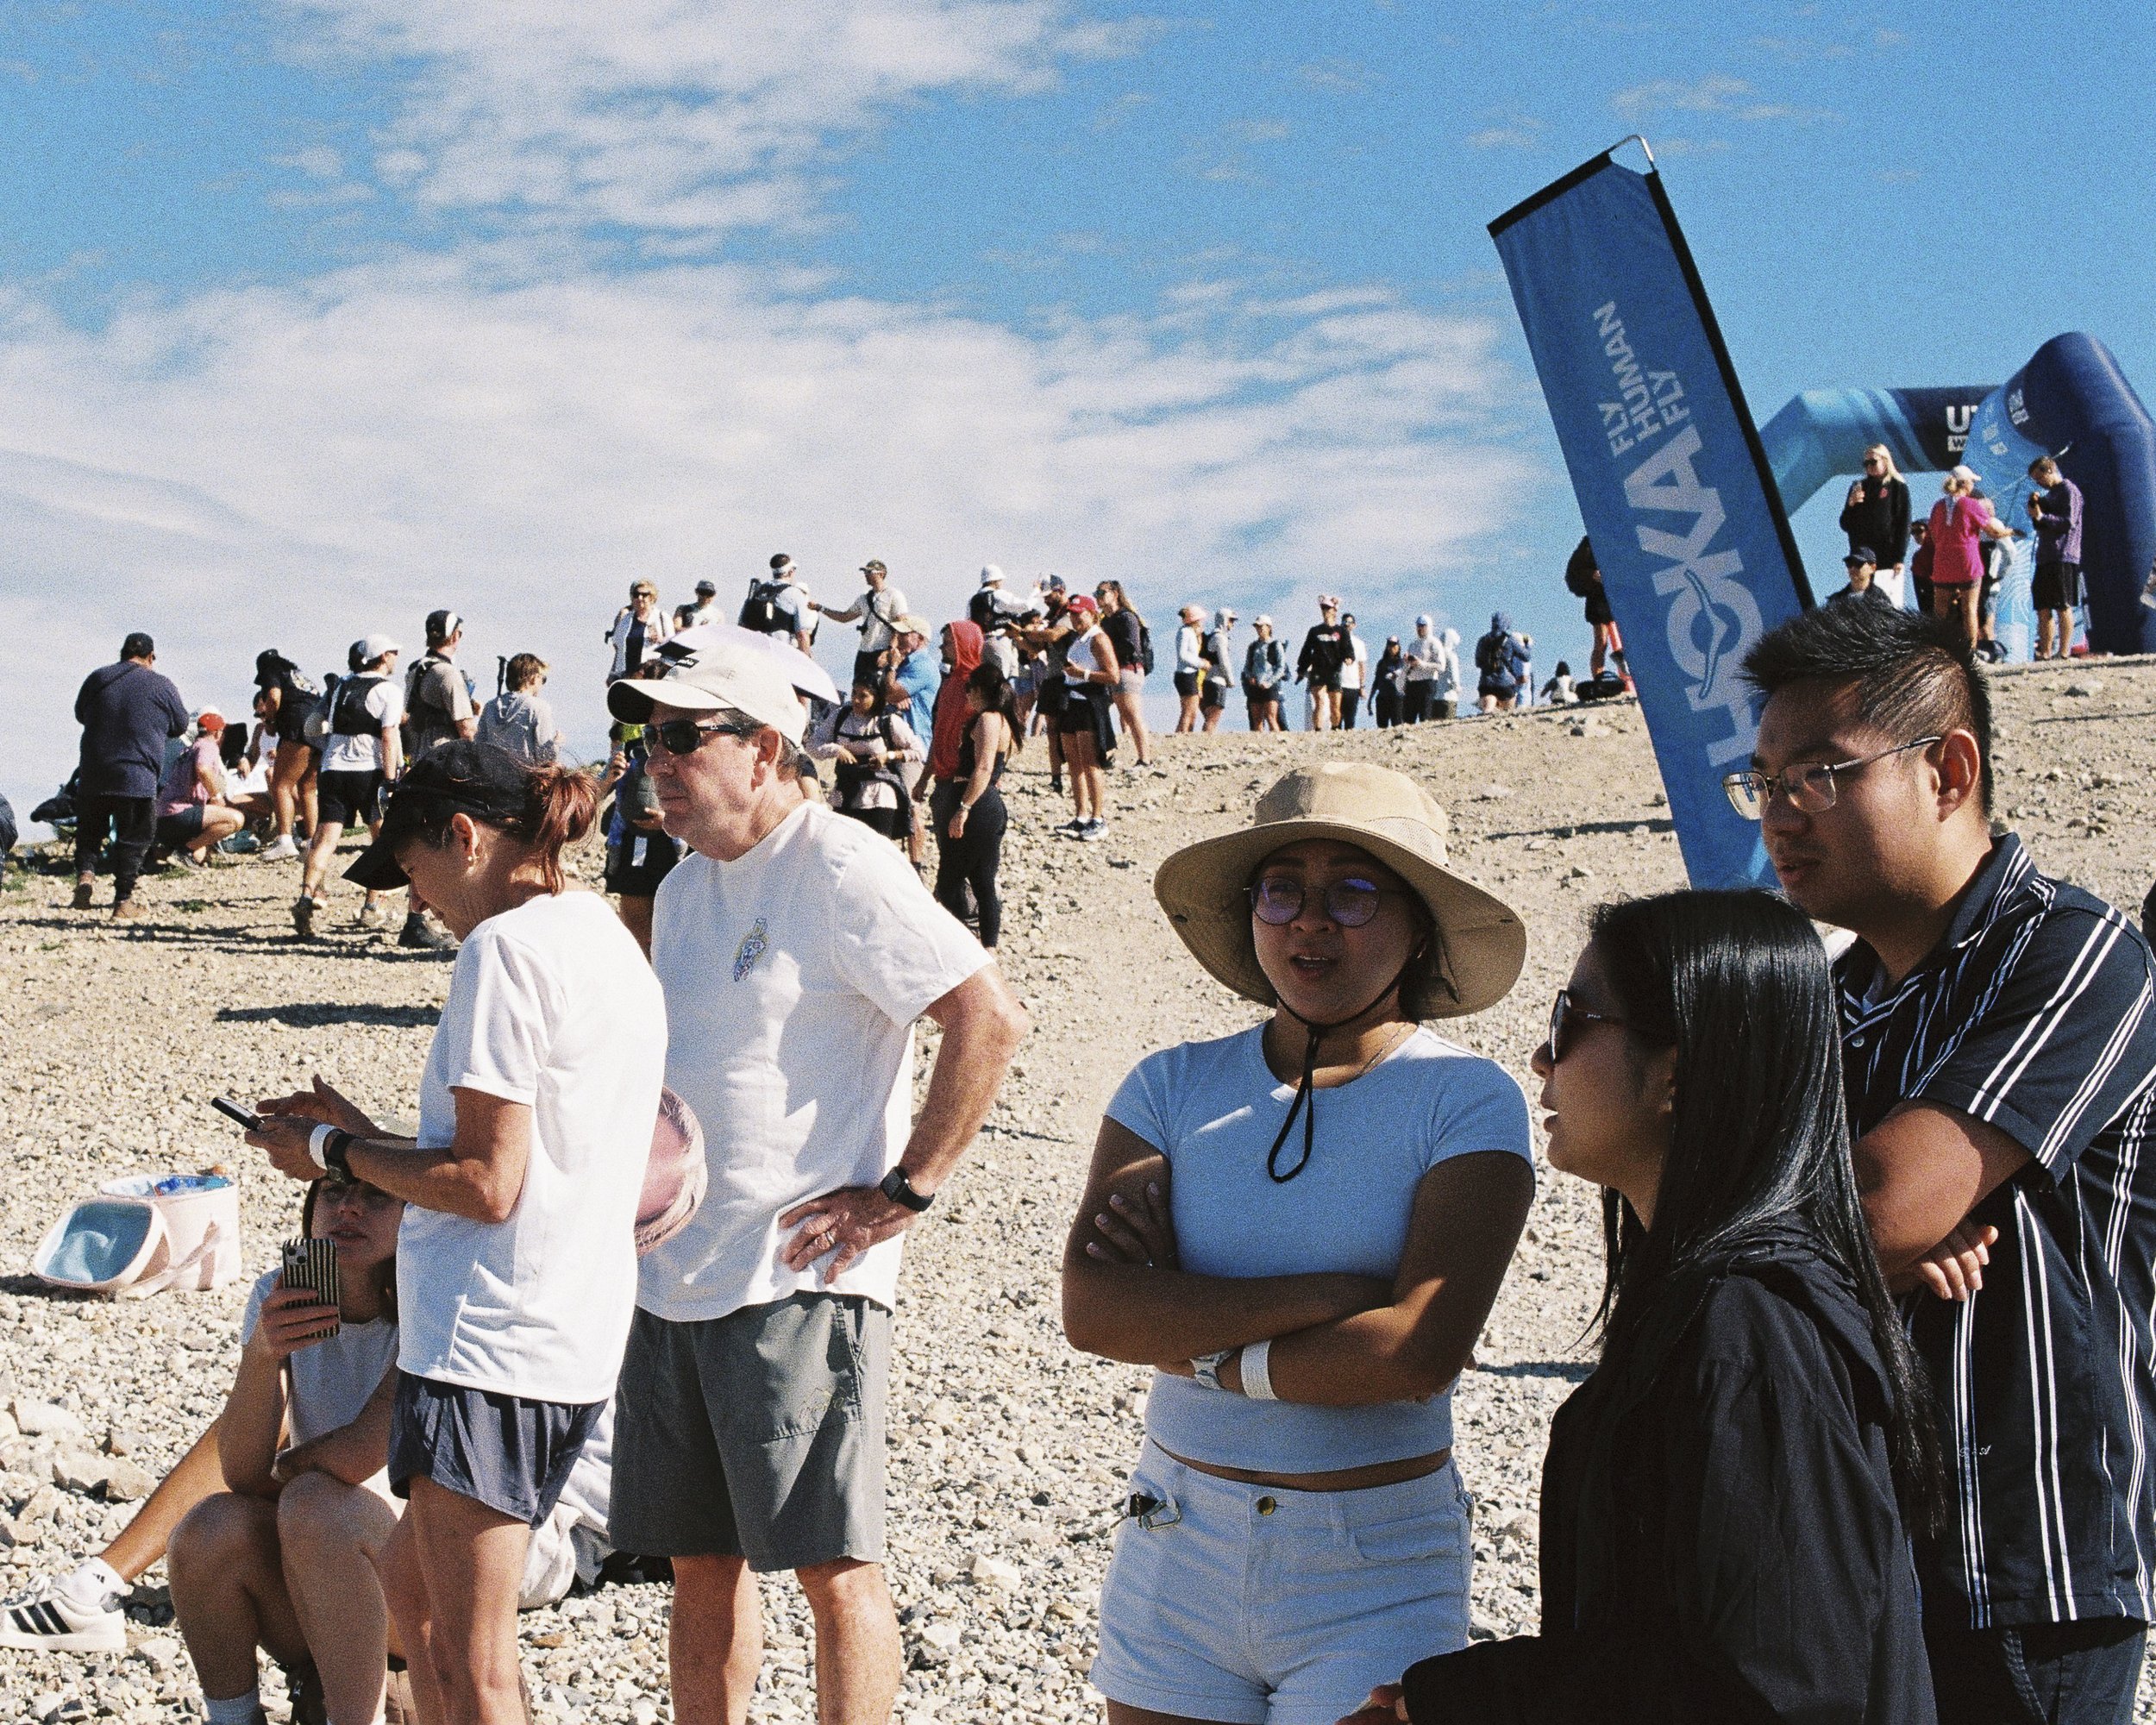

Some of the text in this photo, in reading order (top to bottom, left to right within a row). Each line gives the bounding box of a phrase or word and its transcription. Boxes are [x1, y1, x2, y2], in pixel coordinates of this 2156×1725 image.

[1594, 301, 1662, 442] HUMAN
[1647, 371, 1690, 426] FLY
[1598, 402, 1634, 457] FLY
[1946, 405, 1978, 433] U
[1623, 423, 1764, 768] HOKA
